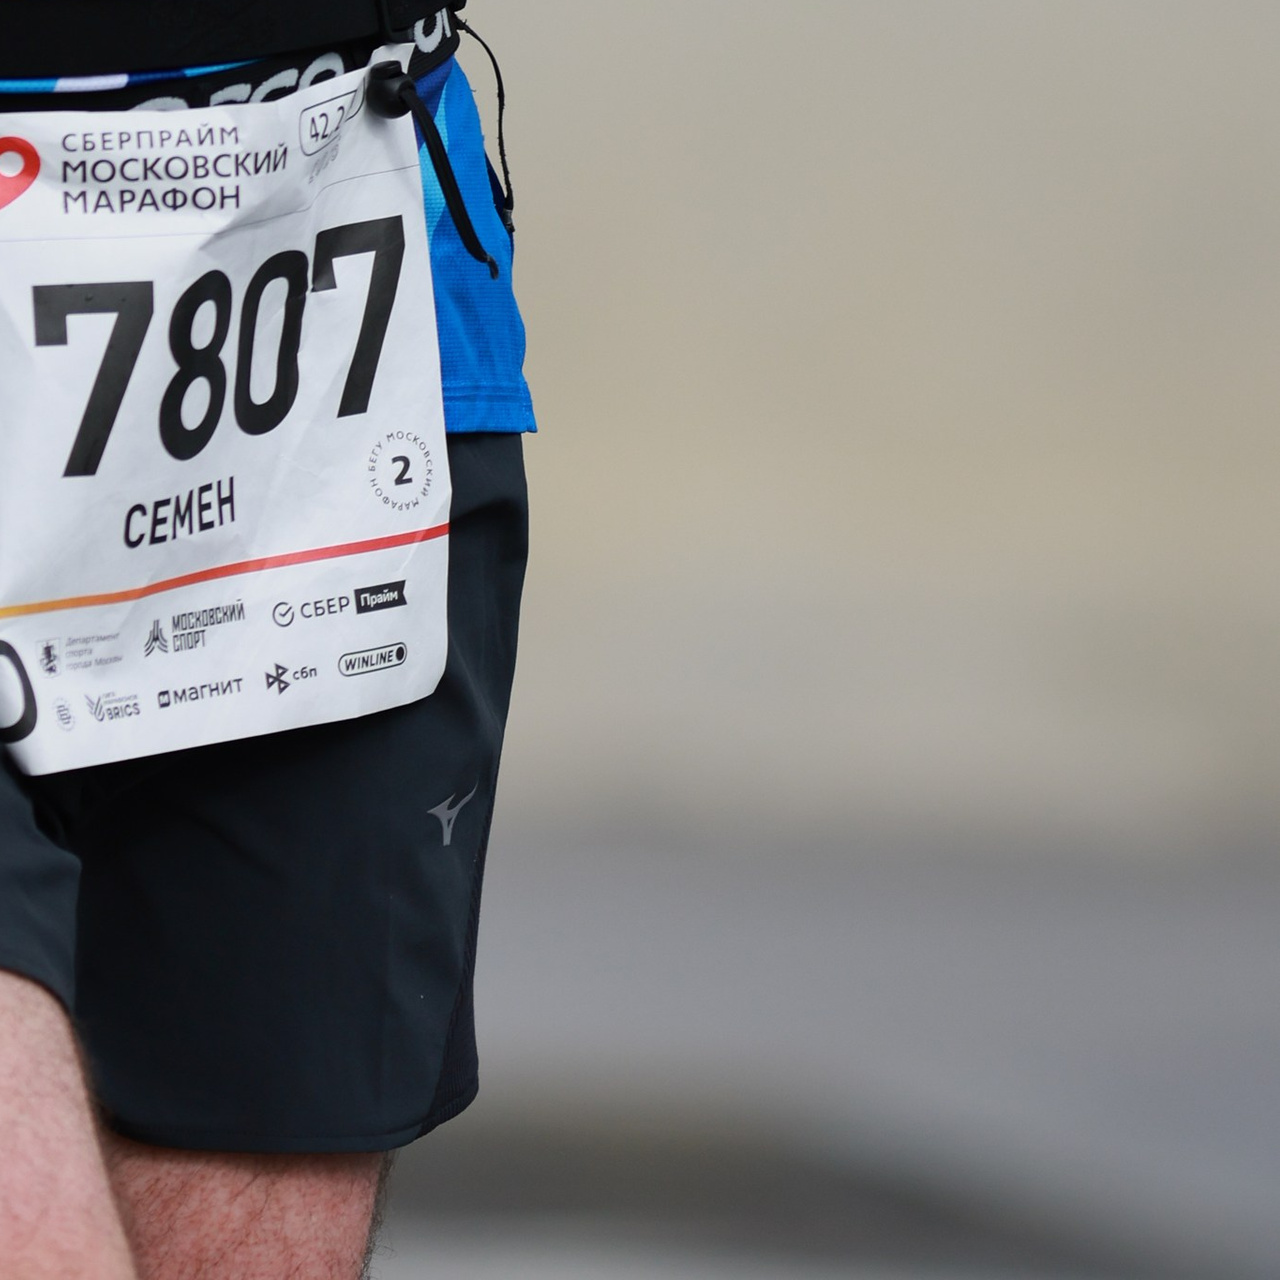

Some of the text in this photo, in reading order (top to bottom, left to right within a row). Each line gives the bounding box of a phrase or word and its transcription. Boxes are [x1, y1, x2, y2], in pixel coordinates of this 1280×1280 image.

[62, 123, 240, 153] СБЕРПРАЙМ
[62, 142, 288, 184] МОСКОВСКИЙ
[62, 185, 240, 214] МАРАФОН
[391, 455, 413, 486] 2
[123, 475, 235, 549] СЕМЕН
[171, 599, 245, 633] МОСКОВСКИЙ
[300, 588, 399, 618] СБЕР Прайм
[172, 629, 206, 652] СПОРТ
[292, 665, 318, 681] сбп
[344, 649, 395, 672] WINLINE
[106, 702, 141, 720] BRICS
